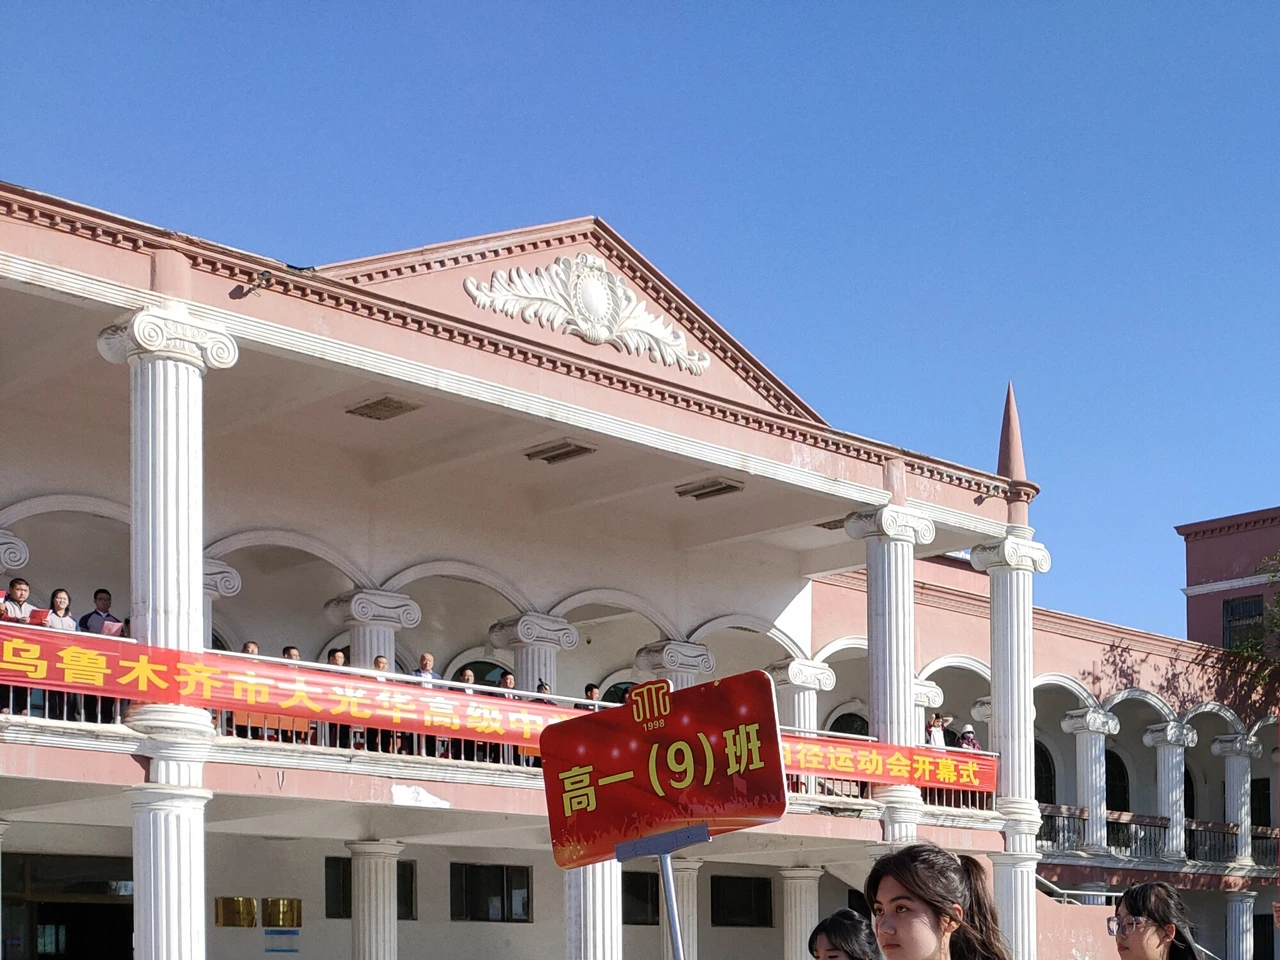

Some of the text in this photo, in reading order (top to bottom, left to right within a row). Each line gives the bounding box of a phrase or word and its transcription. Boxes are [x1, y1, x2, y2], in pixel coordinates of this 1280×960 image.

[0, 638, 576, 738] 乌鲁木齐市大光华高级中
[642, 719, 665, 732] 1998
[558, 722, 765, 818] 高一(9)班
